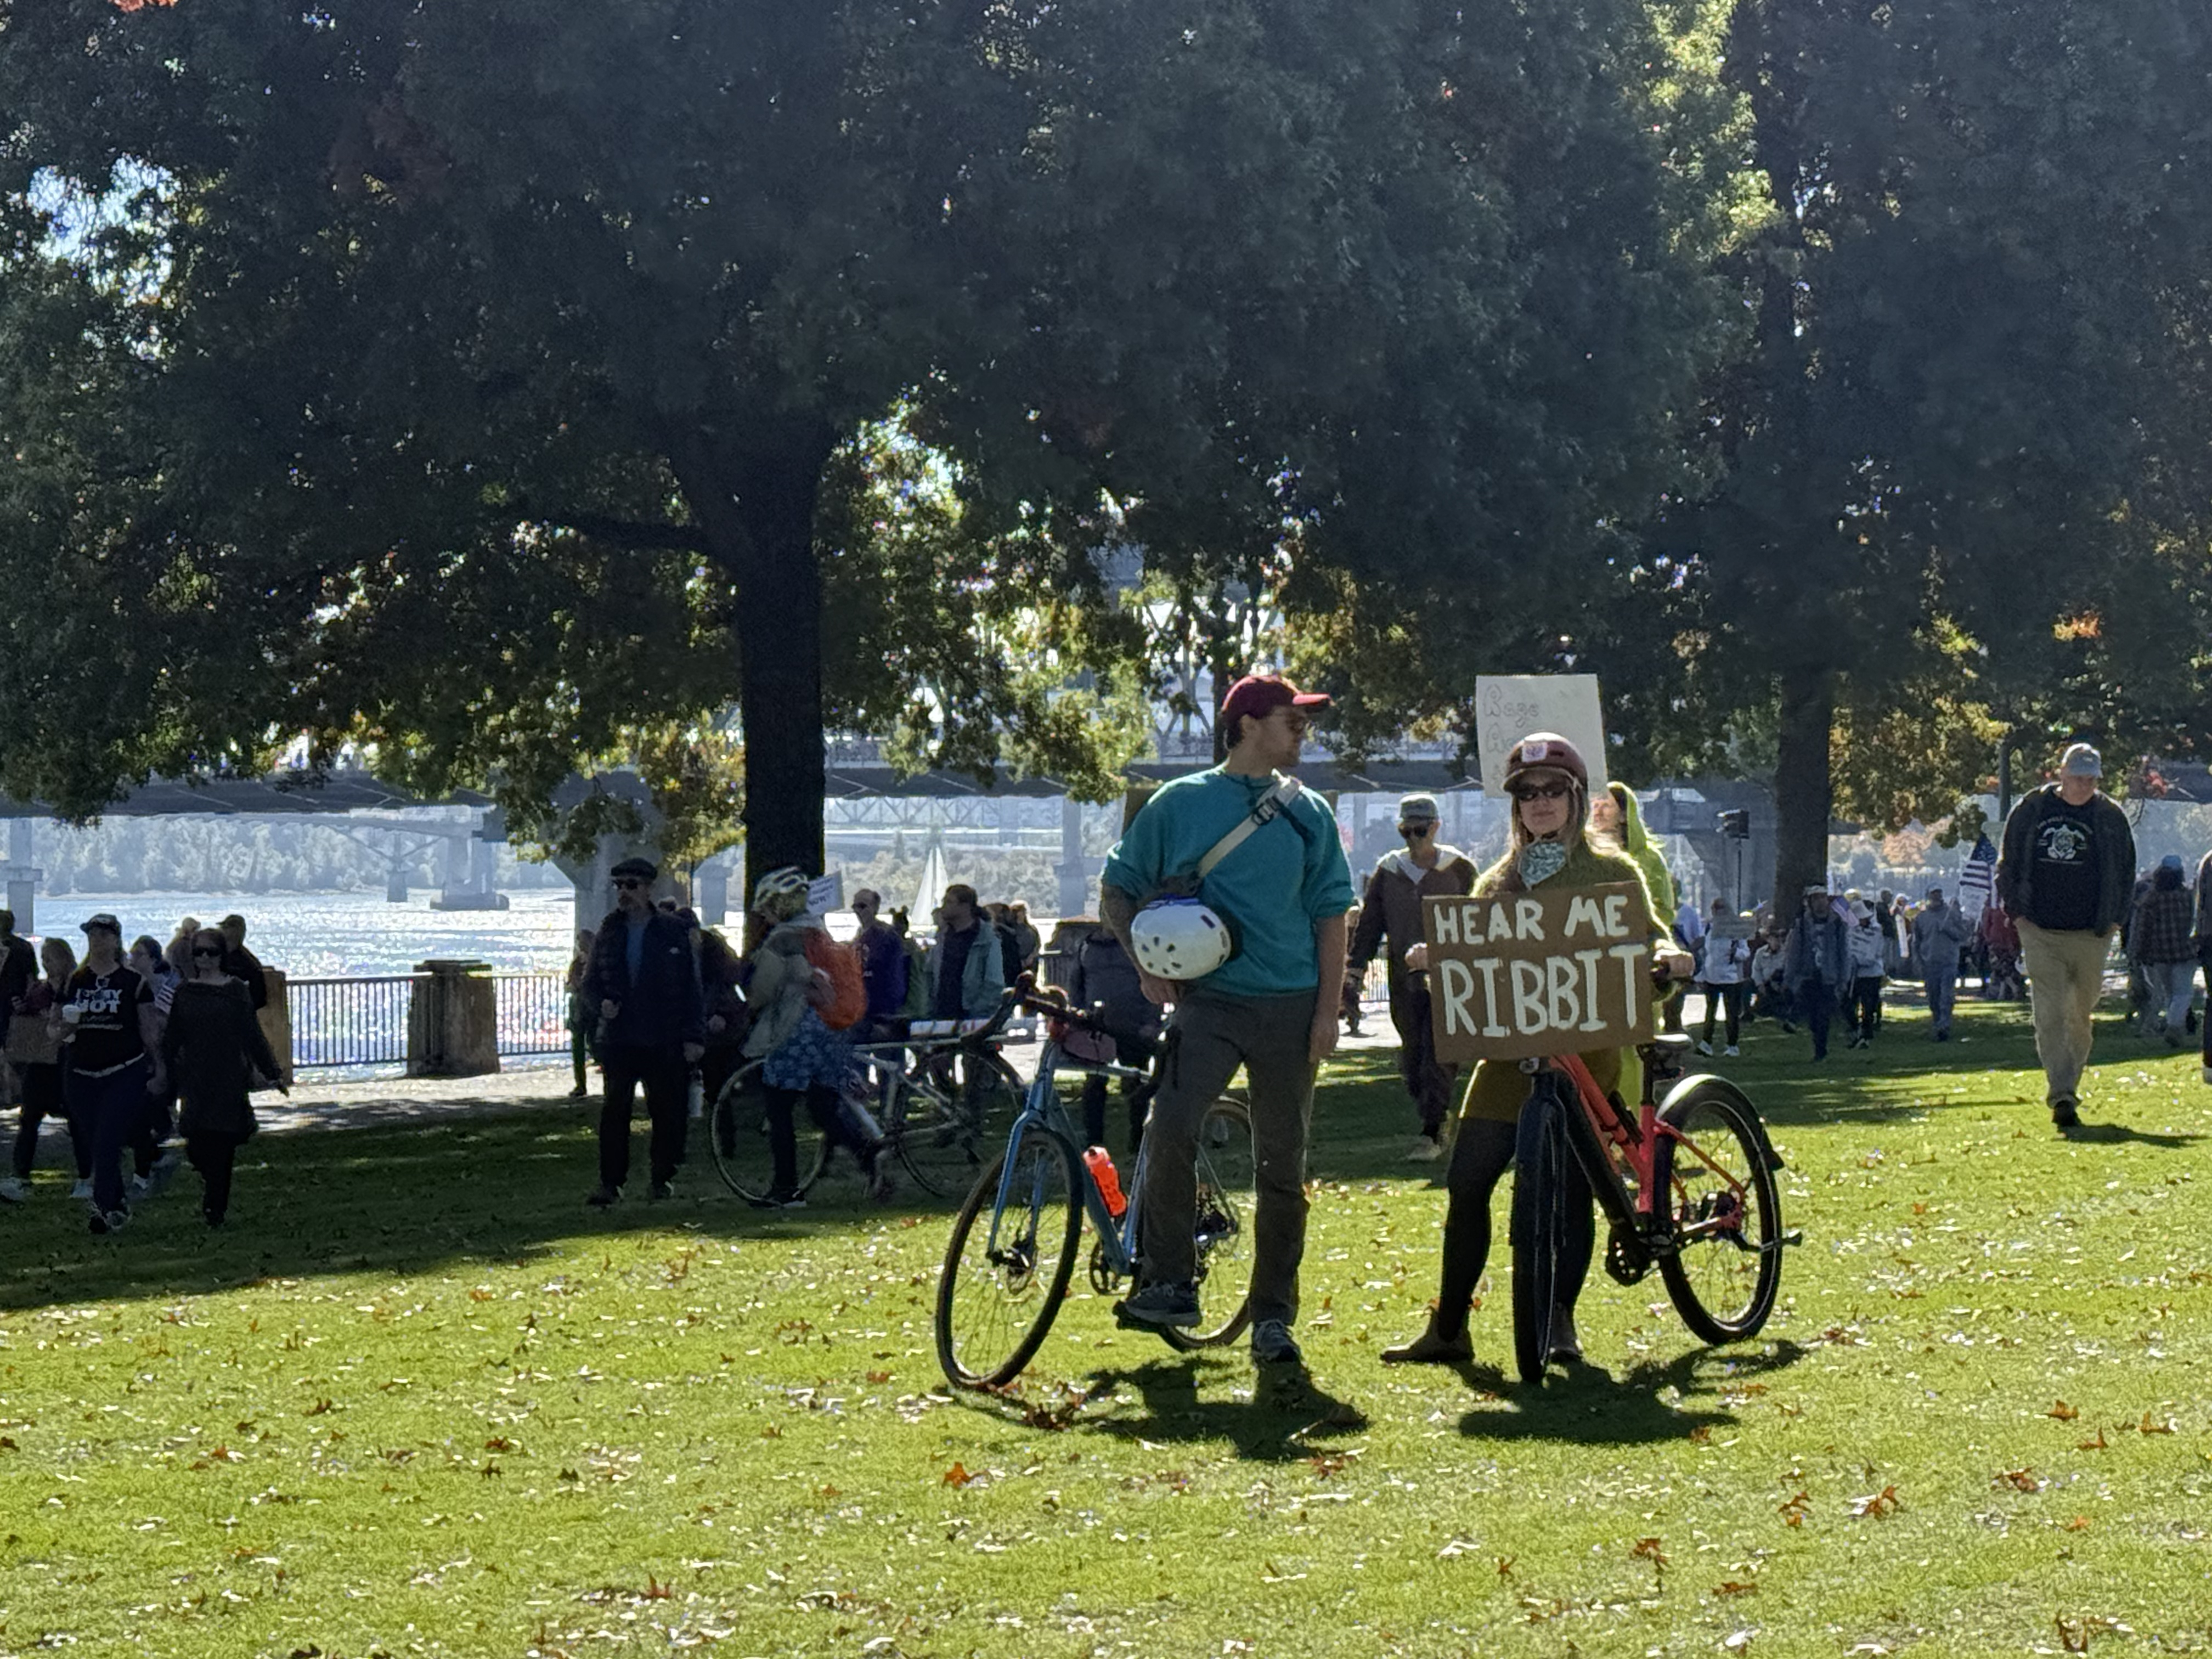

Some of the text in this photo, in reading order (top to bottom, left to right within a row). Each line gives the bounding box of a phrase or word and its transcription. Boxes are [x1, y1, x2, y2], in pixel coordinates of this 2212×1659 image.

[1483, 684, 1539, 728] Rage
[1434, 895, 1630, 945] HEAR ME
[1440, 943, 1648, 1037] RIBBIT
